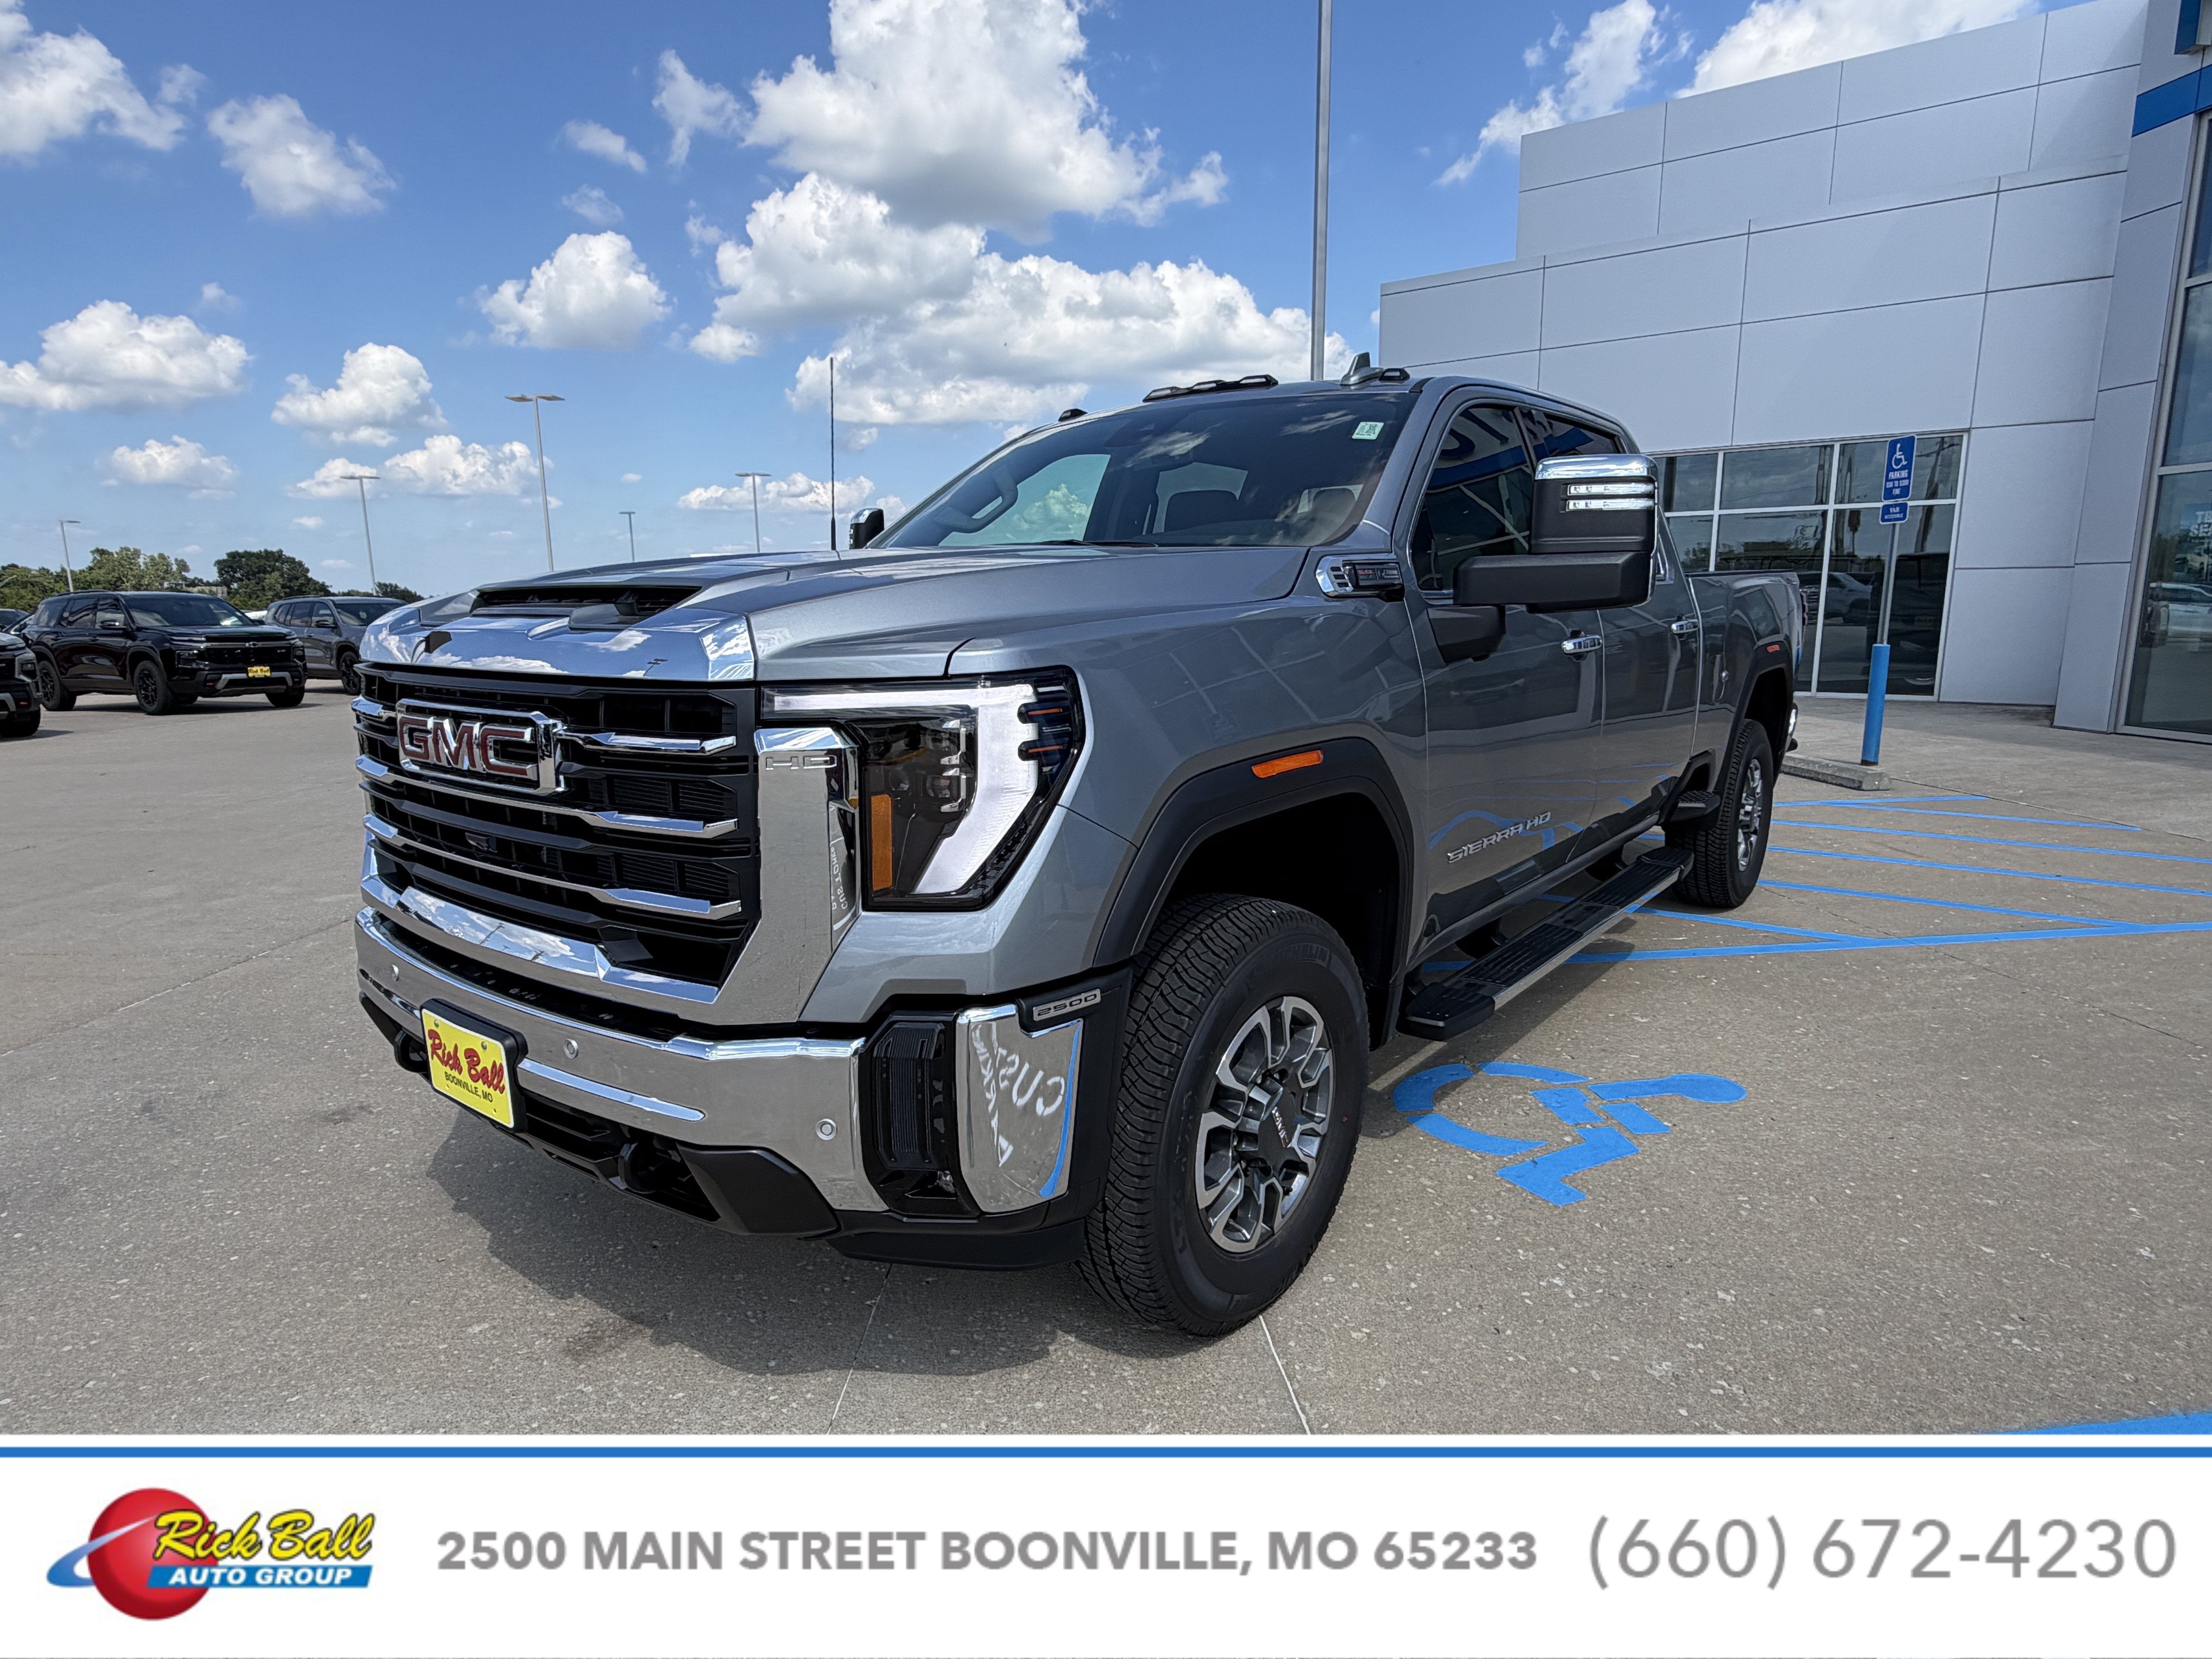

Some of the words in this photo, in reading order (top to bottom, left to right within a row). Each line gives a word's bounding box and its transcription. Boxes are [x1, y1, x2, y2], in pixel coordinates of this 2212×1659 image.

[1888, 469, 1908, 480] PARKING
[398, 716, 538, 780] GMC
[765, 755, 837, 771] HD
[1447, 823, 1523, 864] SIERRA
[1525, 811, 1551, 830] HD
[1037, 993, 1097, 1016] 2500
[427, 1029, 463, 1075] Rick
[464, 1048, 505, 1094] Ball
[444, 1071, 481, 1099] BOONVILLE,
[482, 1089, 493, 1103] MO
